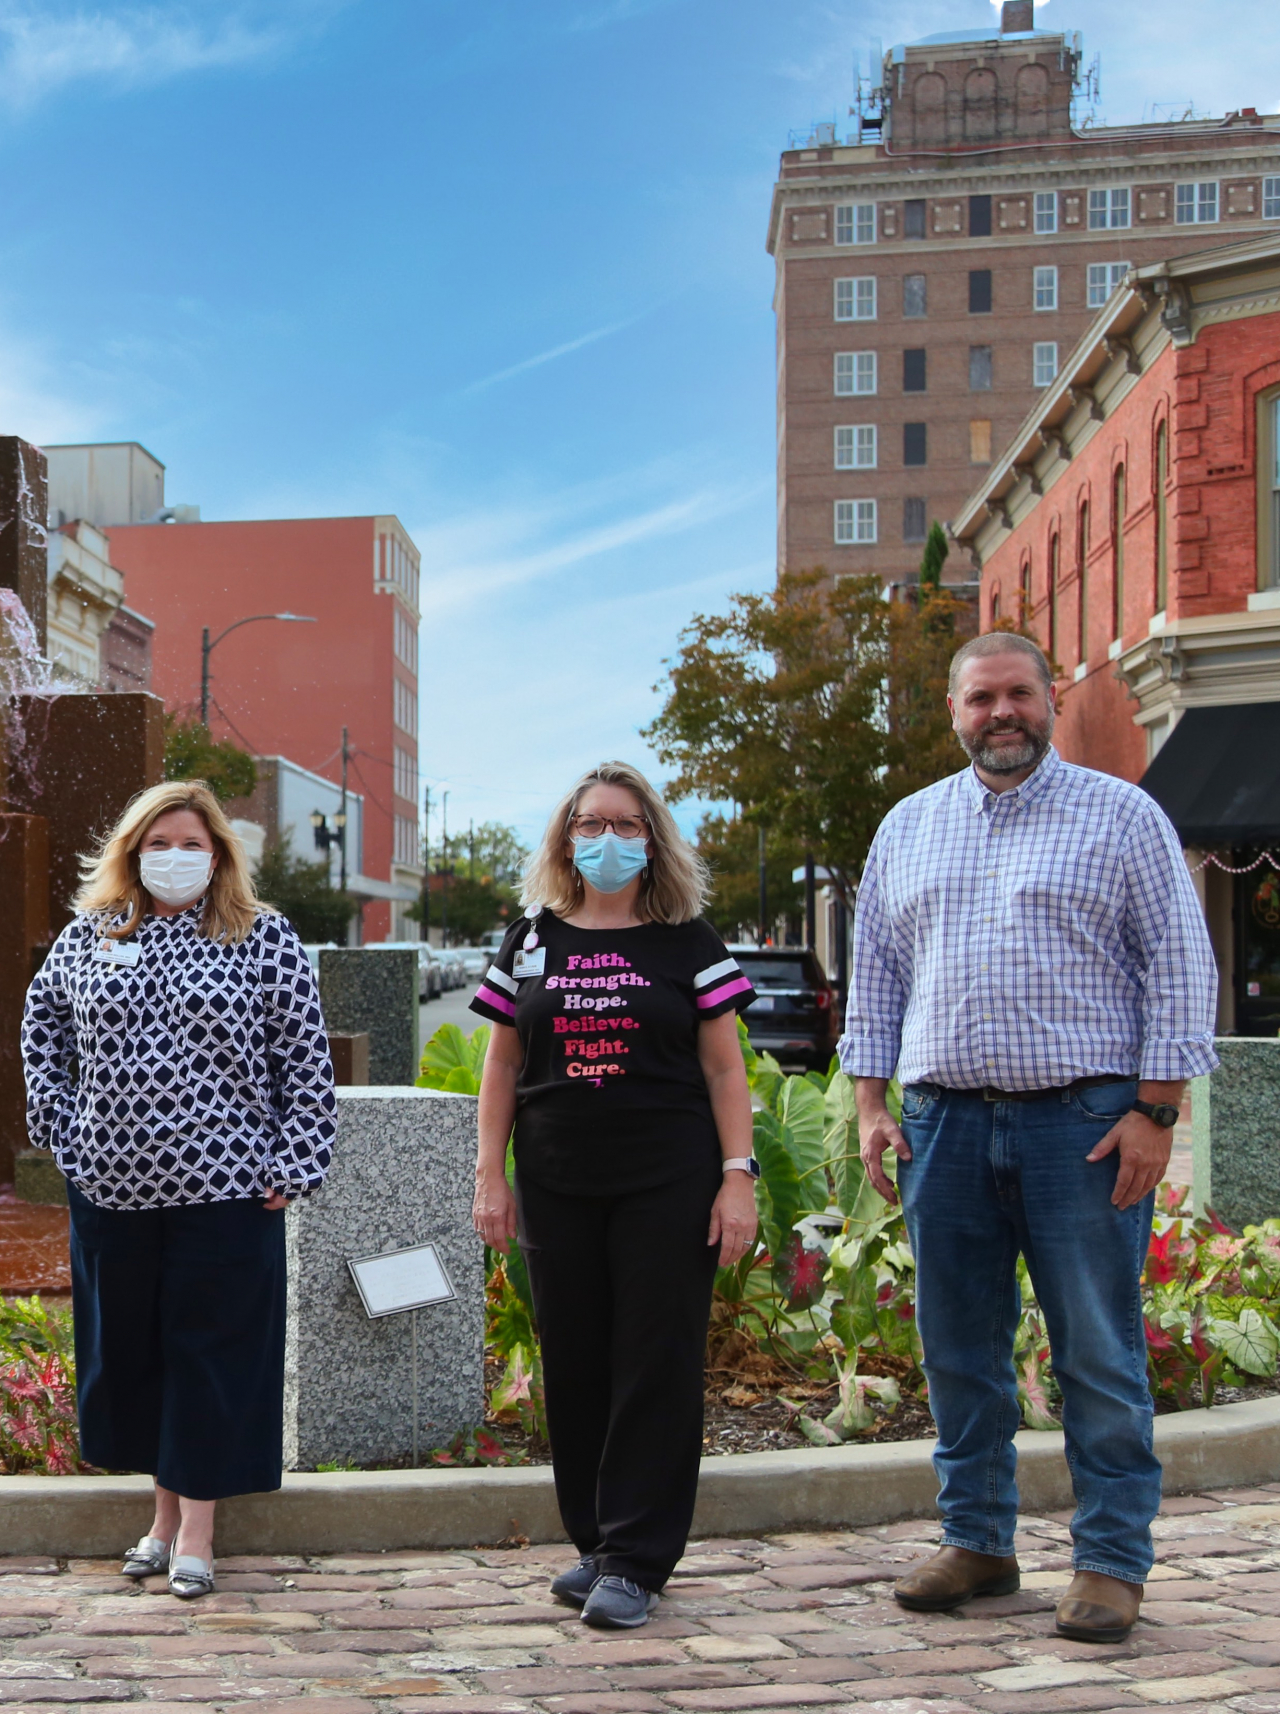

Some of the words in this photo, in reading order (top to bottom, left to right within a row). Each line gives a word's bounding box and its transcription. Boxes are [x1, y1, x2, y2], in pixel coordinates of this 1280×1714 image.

[566, 953, 632, 970] Faith.
[545, 973, 651, 990] Strength.
[563, 994, 628, 1011] Hope.
[552, 1016, 640, 1033] Believe.
[564, 1039, 629, 1059] Fight.
[566, 1062, 626, 1077] Cure.
